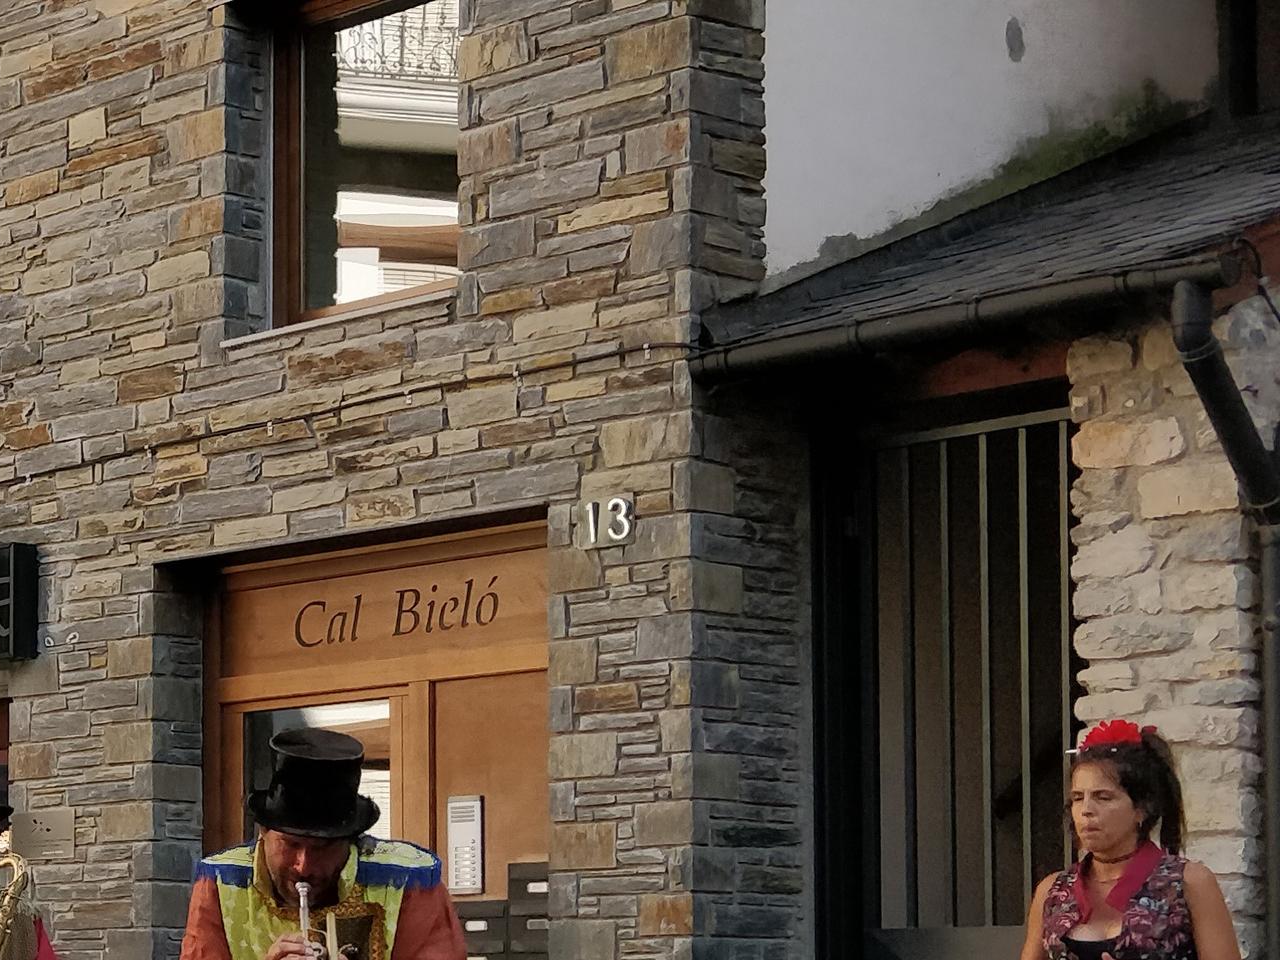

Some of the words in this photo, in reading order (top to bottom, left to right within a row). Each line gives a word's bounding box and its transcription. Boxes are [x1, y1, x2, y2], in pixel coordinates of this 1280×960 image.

[585, 498, 630, 543] 13
[295, 594, 362, 648] Cal
[392, 576, 499, 637] Bieló
